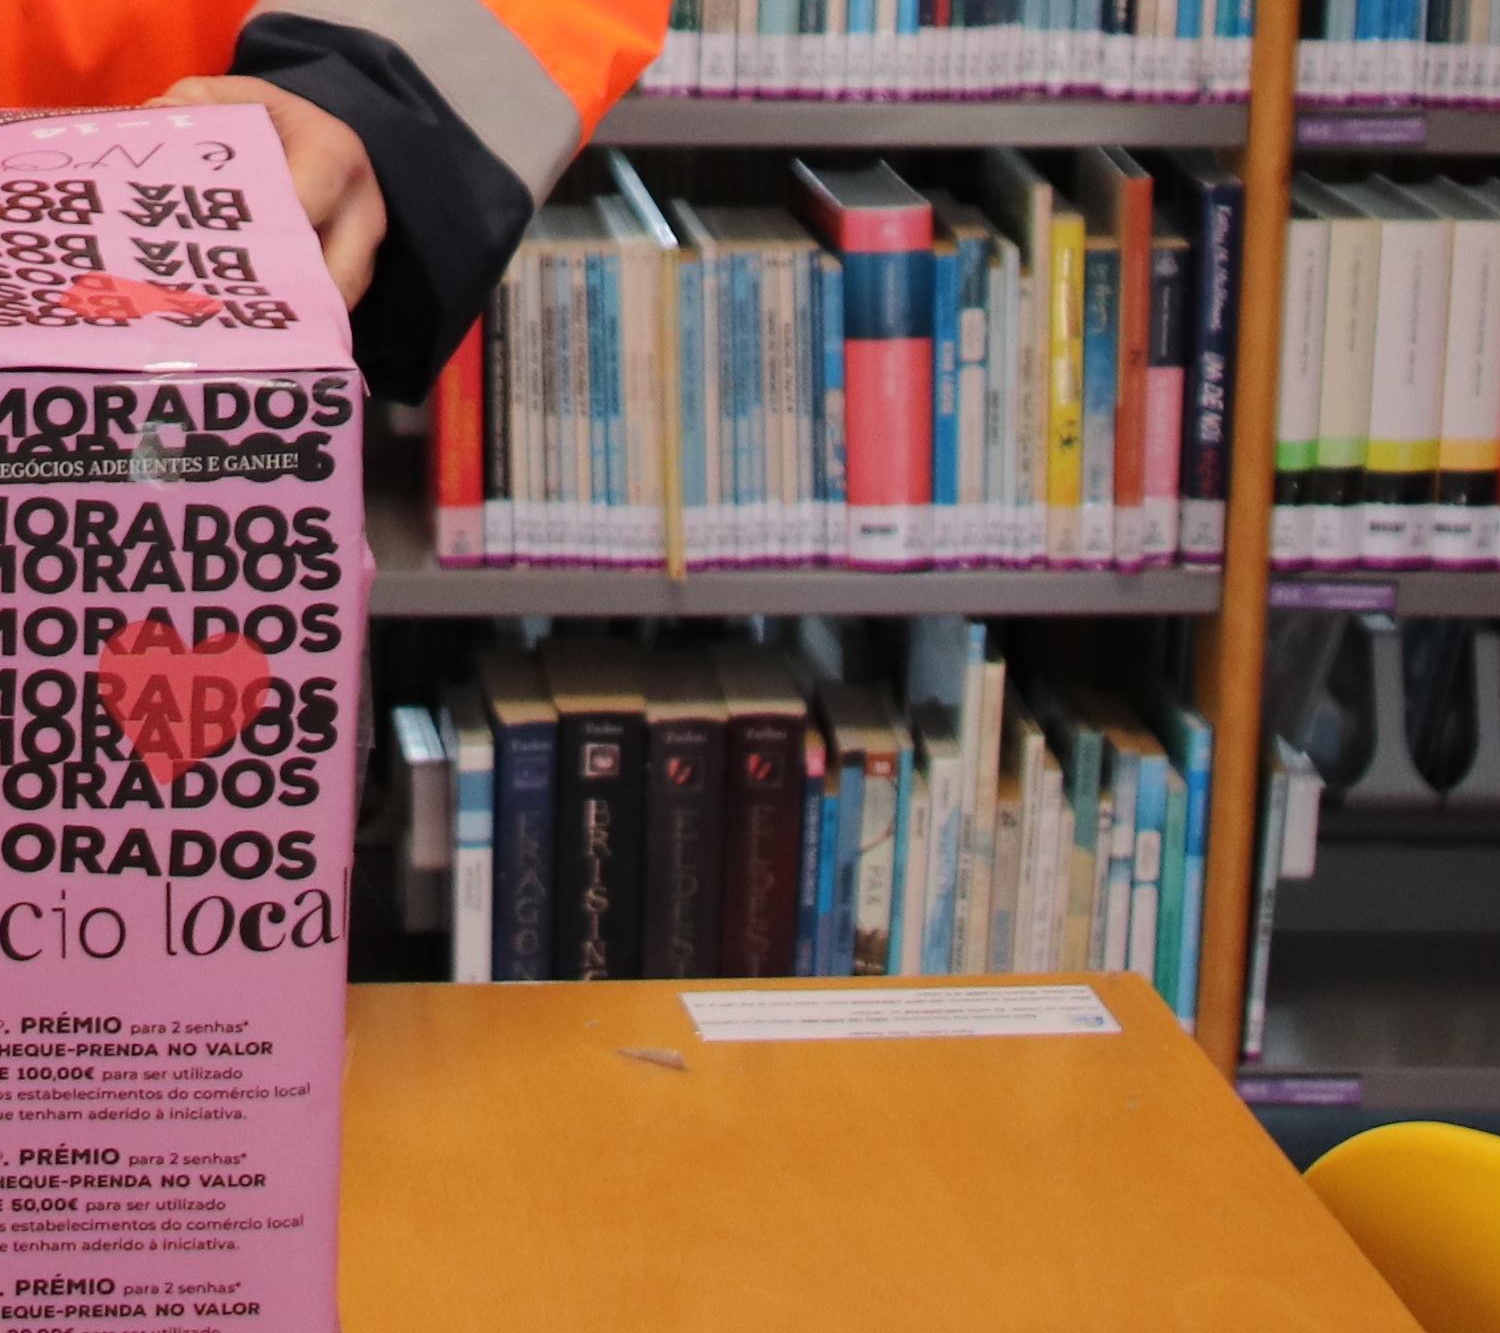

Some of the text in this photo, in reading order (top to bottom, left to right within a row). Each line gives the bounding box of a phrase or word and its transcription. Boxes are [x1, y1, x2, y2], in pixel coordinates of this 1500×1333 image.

[88, 455, 203, 478] ADERENTES
[207, 455, 221, 473] E
[223, 452, 299, 473] GANHE!
[165, 867, 349, 957] local
[20, 1011, 122, 1035] PRÉMIO
[130, 1023, 167, 1037] para
[171, 1021, 182, 1034] 2
[167, 1043, 197, 1057] NO
[205, 1041, 274, 1056] VALOR
[16, 1066, 95, 1083] 100,00€
[102, 1069, 139, 1083] para
[143, 1069, 168, 1081] ser
[173, 1066, 243, 1081] utilizado
[17, 1087, 164, 1101] estabelecimentos
[168, 1086, 189, 1100] do
[193, 1085, 270, 1100] comércio
[273, 1083, 311, 1098] local
[18, 1107, 83, 1121] tenham
[88, 1107, 151, 1121] aderido
[155, 1107, 165, 1120] à
[169, 1107, 247, 1121] iniciativa.
[19, 1143, 121, 1166] PRÉMIO
[128, 1155, 165, 1168] para
[169, 1153, 179, 1165] 2
[160, 1175, 191, 1189] NO
[198, 1174, 267, 1188] VALOR
[11, 1198, 79, 1215] 50,00€
[85, 1200, 122, 1214] para
[126, 1200, 151, 1211] ser
[156, 1198, 226, 1211] utilizado
[11, 1218, 157, 1232] estabelecimentos
[161, 1217, 182, 1231] do
[186, 1216, 263, 1231] comércio
[267, 1214, 304, 1229] local
[12, 1239, 77, 1252] tenham
[81, 1238, 145, 1252] aderido
[148, 1238, 158, 1251] à
[163, 1238, 240, 1251] iniciativa.
[15, 1273, 116, 1296] PRÉMIO
[123, 1284, 160, 1298] para
[164, 1282, 174, 1294] 2
[155, 1304, 186, 1318] NO
[193, 1303, 261, 1317] VALOR
